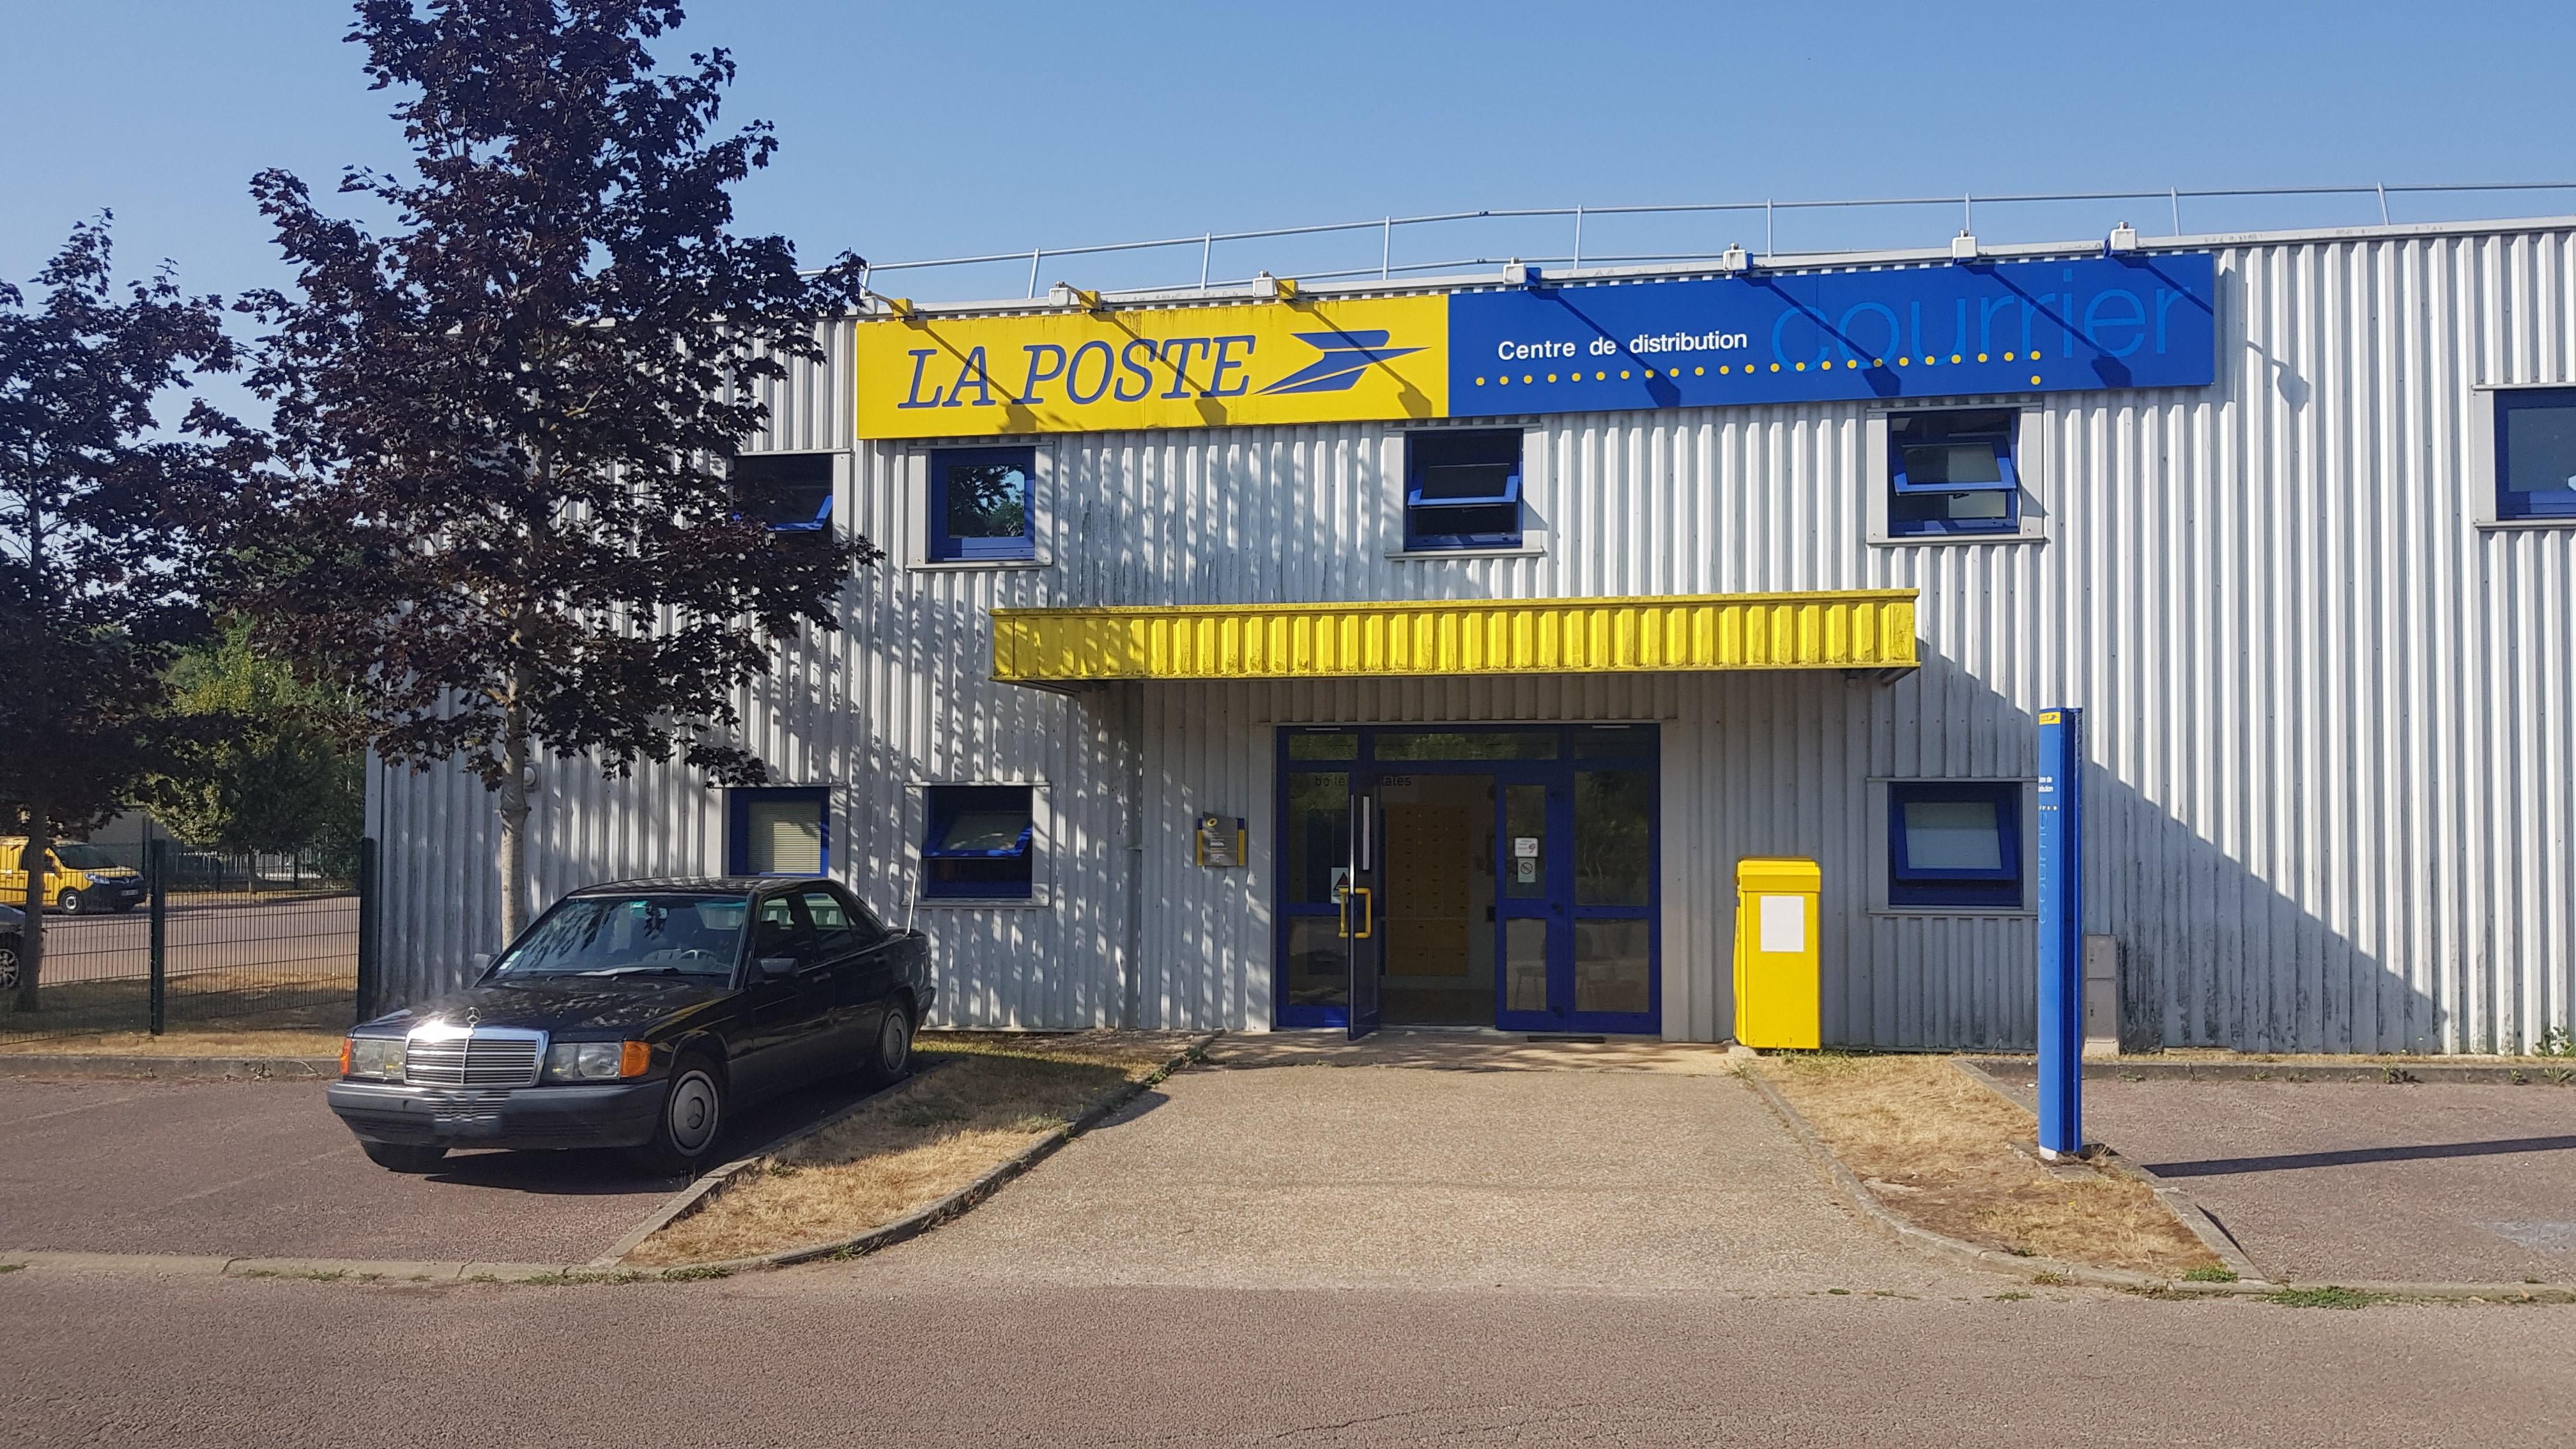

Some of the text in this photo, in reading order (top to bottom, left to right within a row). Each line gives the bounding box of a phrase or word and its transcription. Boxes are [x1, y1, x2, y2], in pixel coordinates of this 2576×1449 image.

[1498, 330, 1748, 361] Centre de distribution
[1772, 268, 2191, 372] courrier
[897, 335, 1257, 409] LA POSTE
